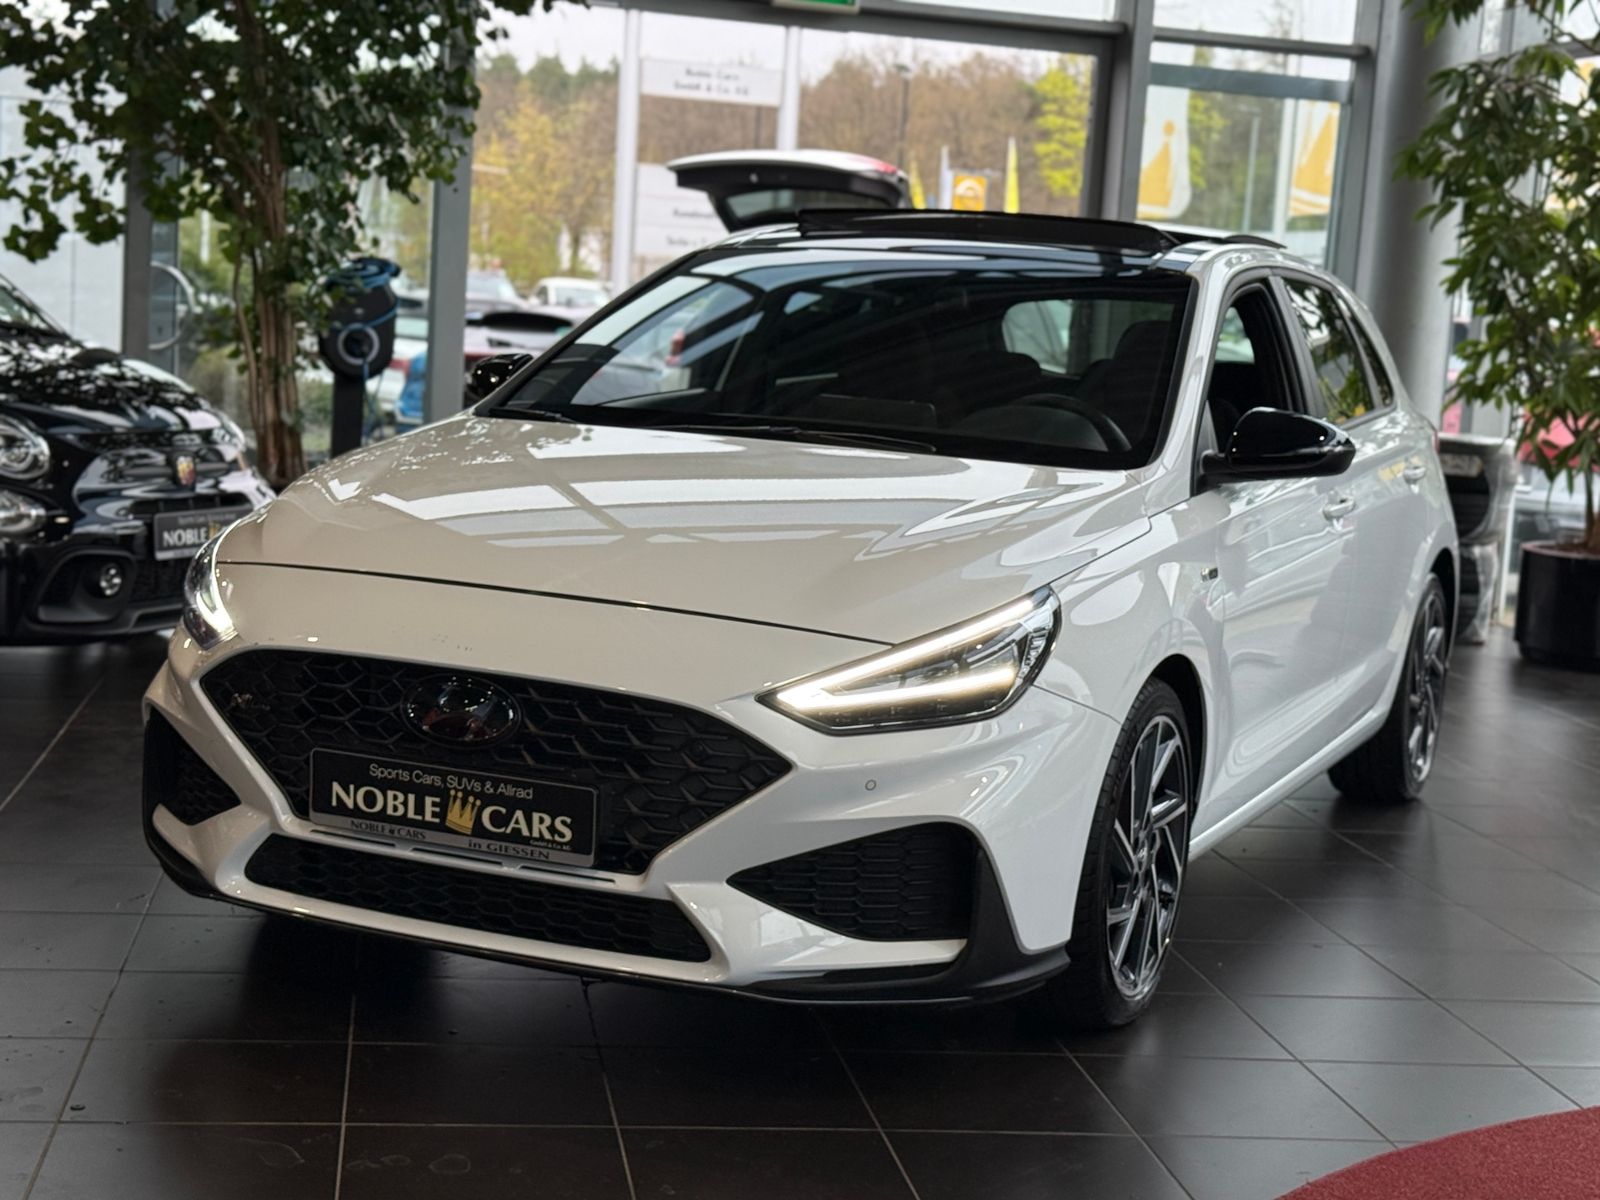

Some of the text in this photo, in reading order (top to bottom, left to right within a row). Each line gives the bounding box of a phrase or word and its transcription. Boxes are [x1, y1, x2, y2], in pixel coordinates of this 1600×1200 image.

[163, 527, 208, 547] NOBLE
[369, 763, 534, 800] Sports Cars, SUVs & Allrad
[331, 781, 573, 843] NOBLE CARS
[350, 819, 426, 840] NOBLE CARS
[468, 838, 549, 860] in GIESSEN
